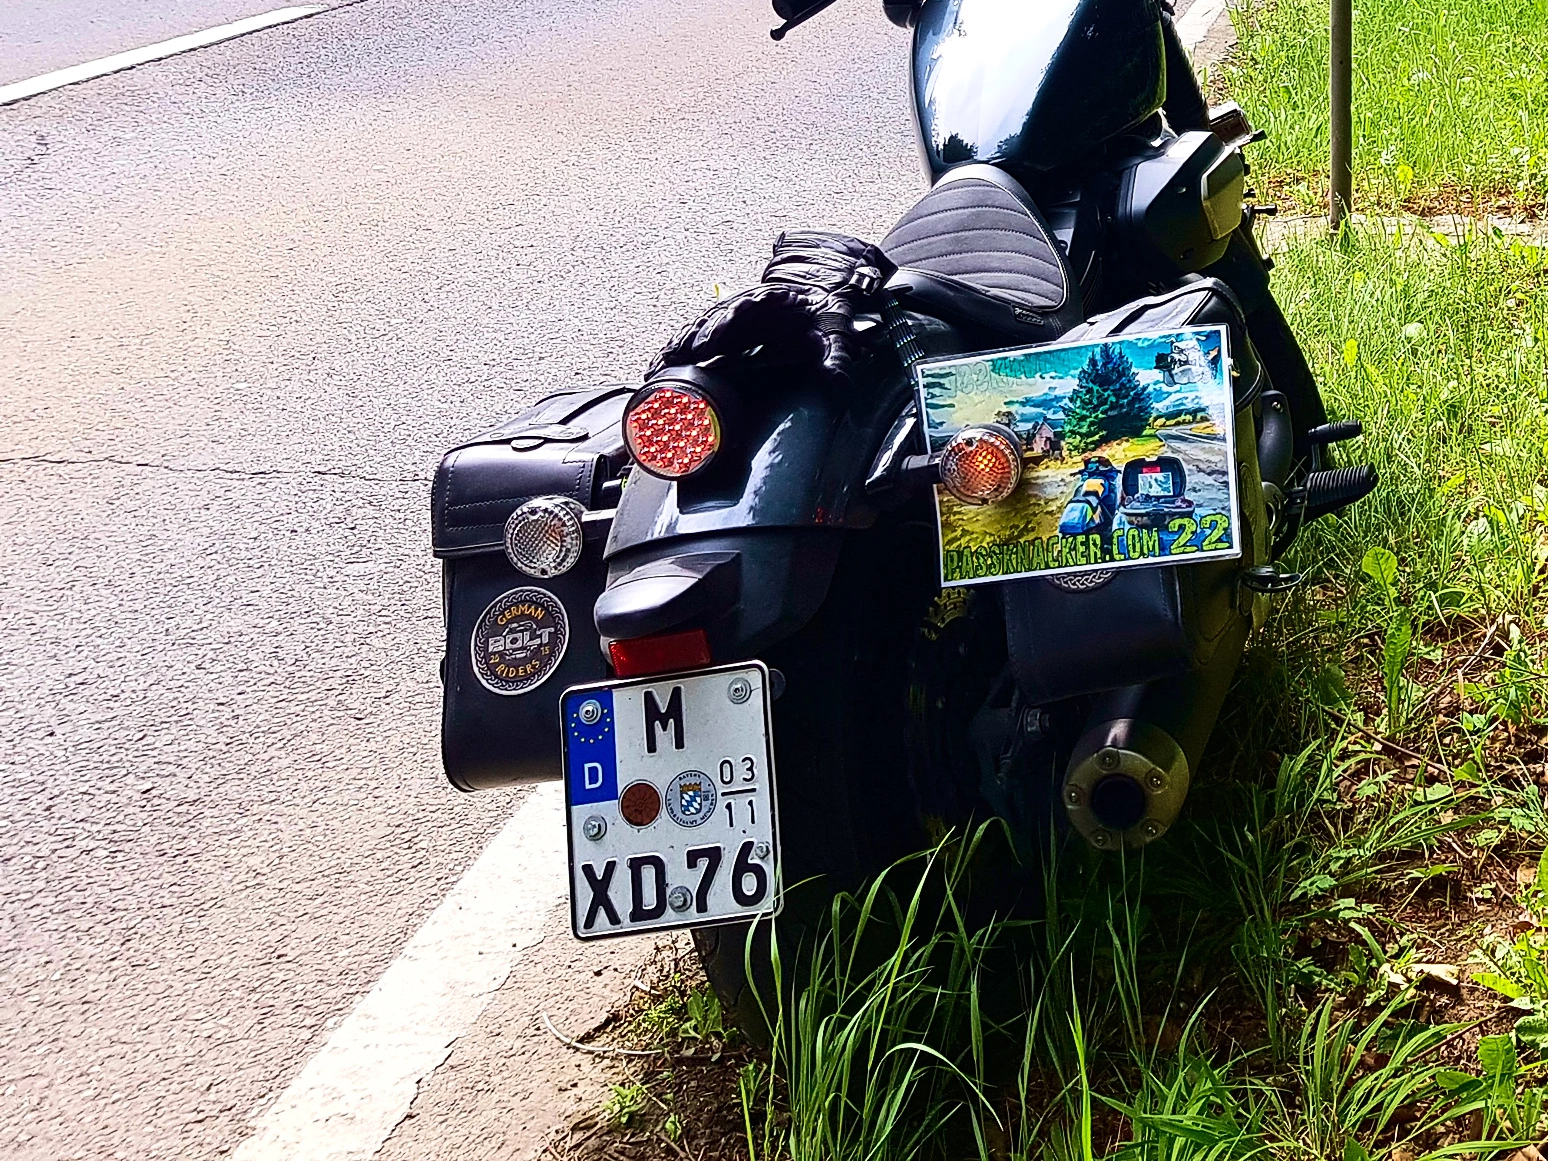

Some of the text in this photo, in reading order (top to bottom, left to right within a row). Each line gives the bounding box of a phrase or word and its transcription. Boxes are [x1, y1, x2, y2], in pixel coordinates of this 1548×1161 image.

[1167, 514, 1230, 554] 22
[497, 603, 545, 625] GERMAN
[488, 627, 554, 653] BOLT
[495, 659, 540, 677] RIDERS
[643, 686, 685, 754] M
[584, 762, 603, 789] D
[719, 756, 755, 785] 03
[724, 799, 756, 827] 11
[581, 840, 768, 930] XD 76
